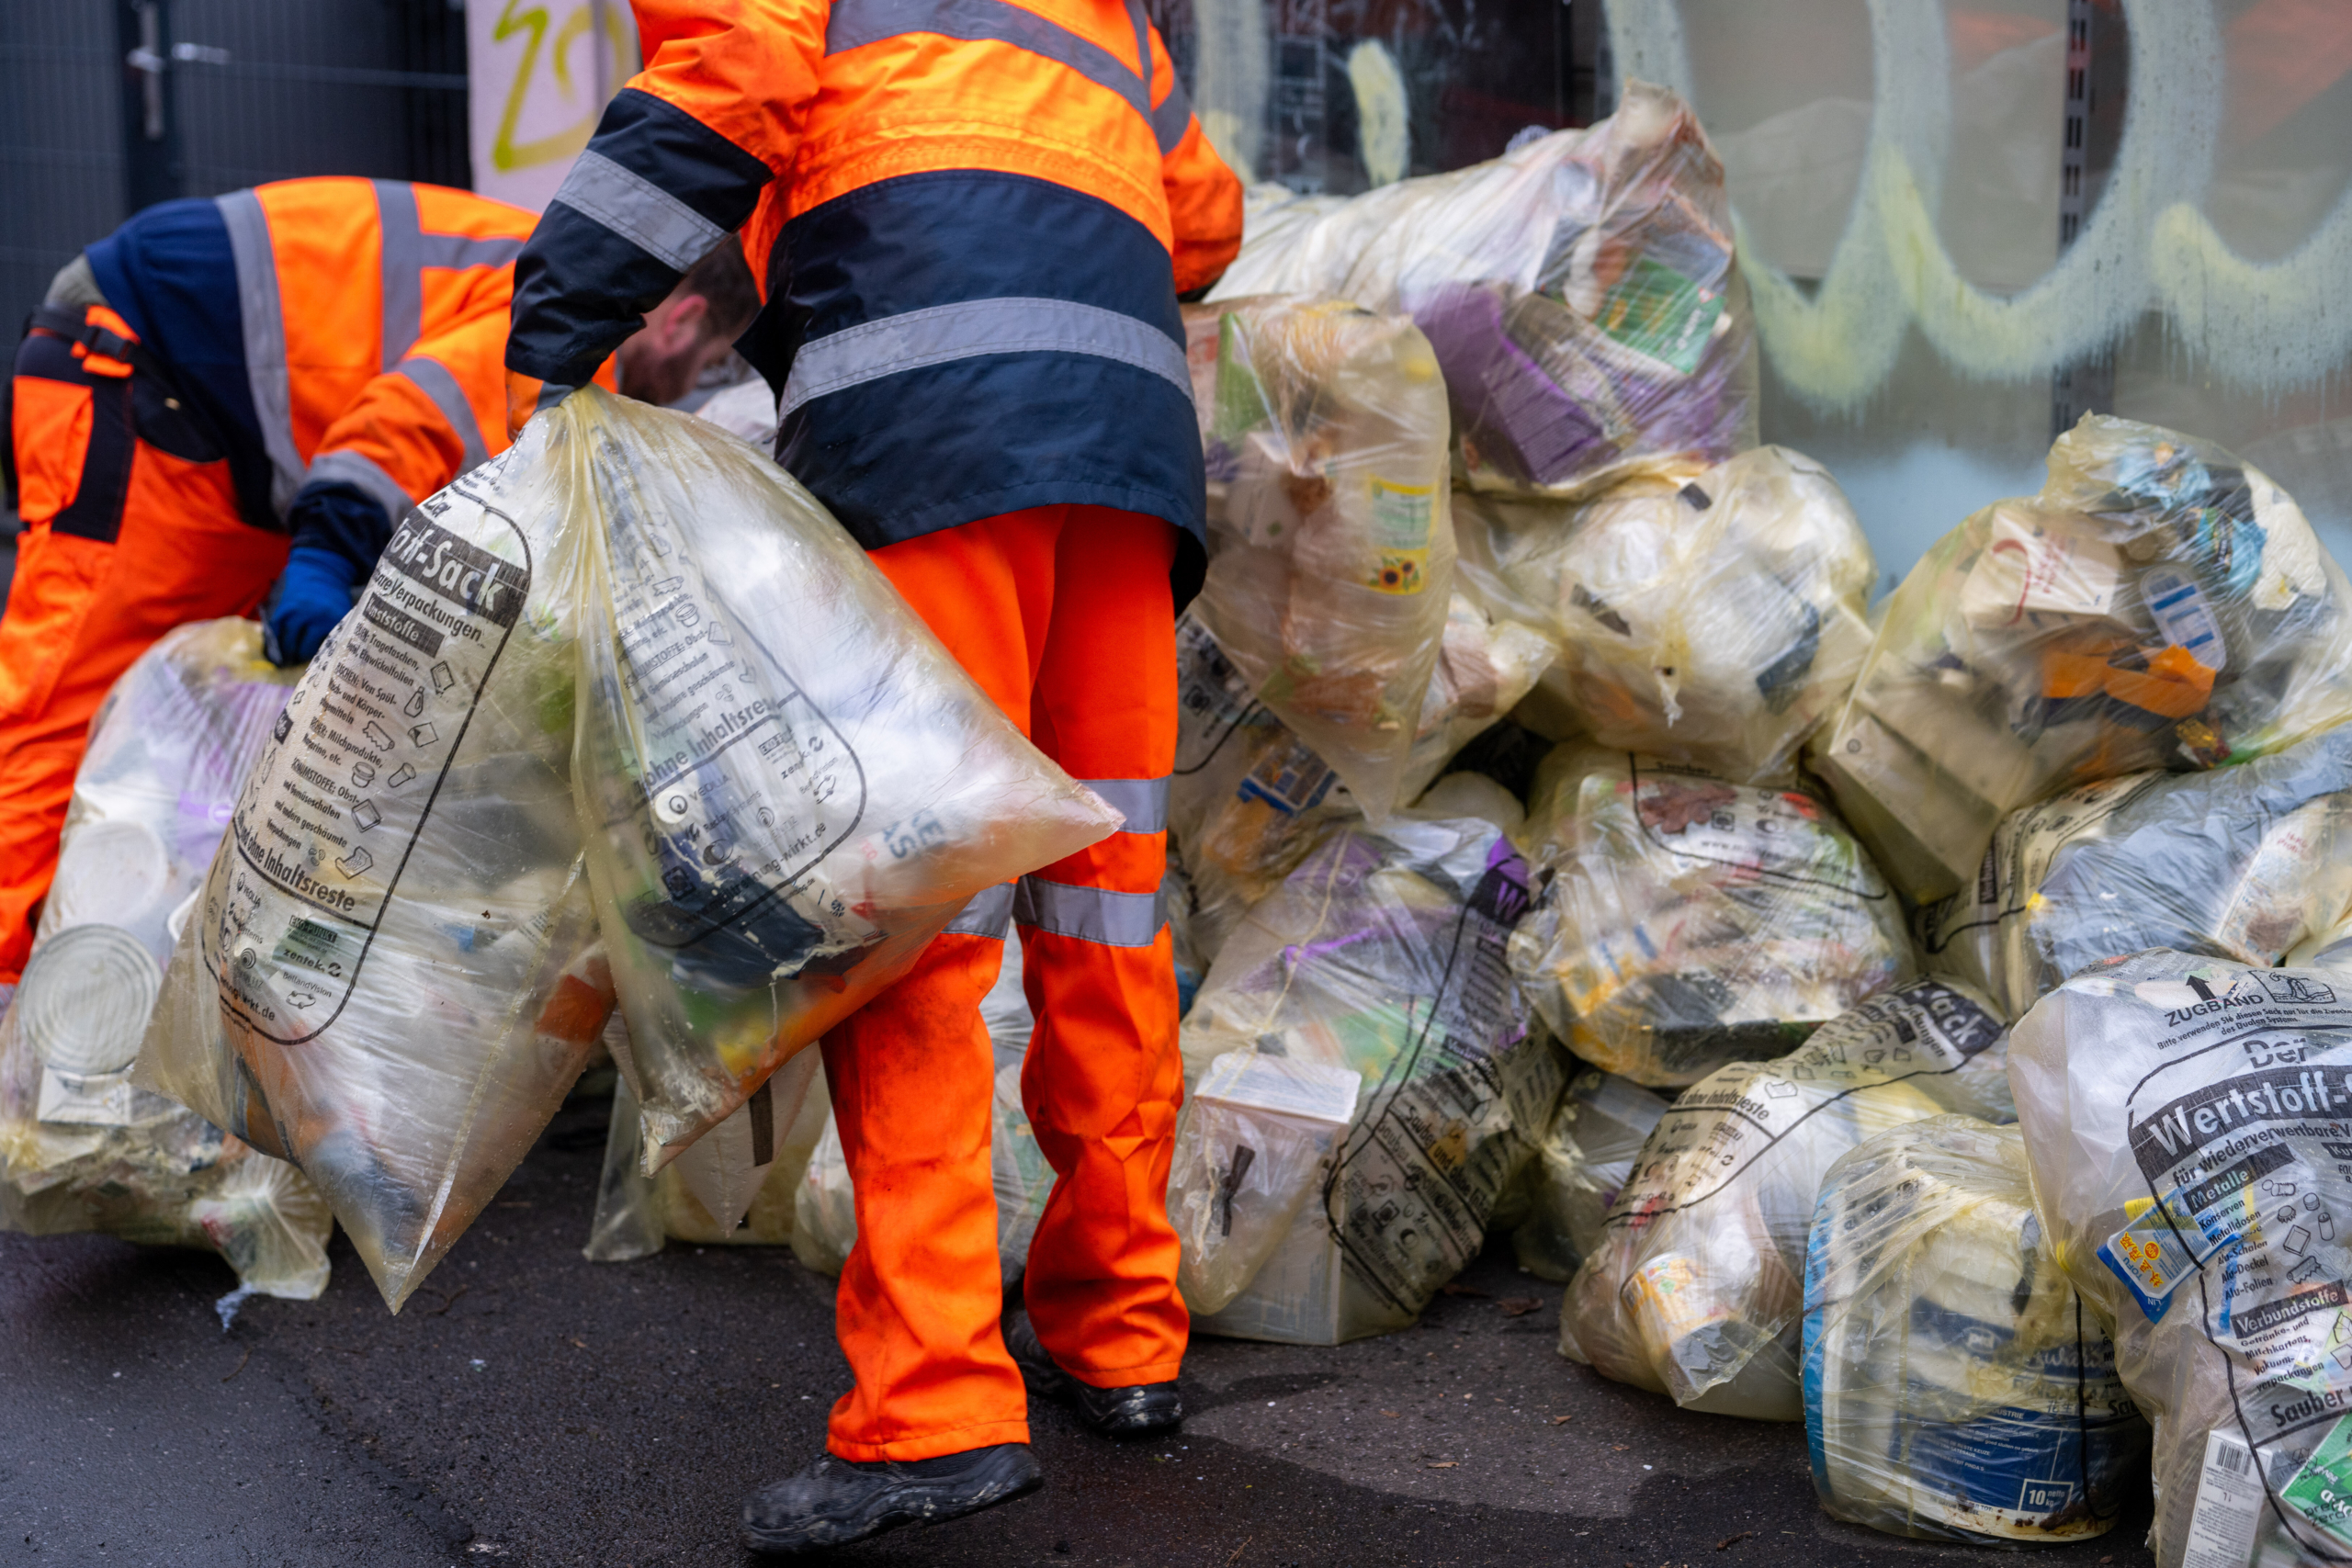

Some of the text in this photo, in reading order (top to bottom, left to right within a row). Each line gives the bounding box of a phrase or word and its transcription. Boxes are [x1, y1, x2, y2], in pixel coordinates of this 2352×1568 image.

[369, 633, 419, 671] Tragetaschen,
[361, 678, 377, 695] Von
[376, 687, 398, 705] Spül-
[342, 692, 356, 705] und
[356, 697, 386, 721] Körper-
[327, 728, 384, 769] Milchprodukte,
[328, 752, 342, 766] etc.
[645, 750, 689, 785] ohne
[290, 784, 342, 820] Gemüseschalen
[337, 785, 360, 805] Obst-
[688, 774, 729, 801] VEOLIA
[301, 818, 349, 849] geschäumte
[264, 847, 356, 912] Inhaltsreste
[288, 915, 338, 943] EKO-PUNKT
[282, 971, 332, 998] BellandVision
[2164, 994, 2264, 1028] ZUGBAND
[2156, 1035, 2178, 1051] Bitte
[2177, 1019, 2222, 1043] verwenden
[2234, 1010, 2263, 1021] diesen
[2263, 1008, 2282, 1017] Sack
[2221, 1023, 2236, 1036] des
[2236, 1018, 2267, 1031] Dualen
[2243, 1037, 2309, 1069] Der
[1405, 1105, 1439, 1148] Sauber
[2172, 1166, 2198, 1189] für
[2198, 1122, 2339, 1174] wiederverwertbare
[2191, 1169, 2251, 1209] Metalle
[2199, 1199, 2245, 1231] Konserven
[2208, 1210, 2262, 1247] Metalldosen
[2122, 1257, 2143, 1281] TOFU
[2221, 1255, 2269, 1284] Alu-Deckel
[2147, 1296, 2163, 1306] LIN
[2224, 1278, 2273, 1301] Alu-Folien
[2236, 1288, 2339, 1333] Verbundstoffe
[2240, 1315, 2310, 1347] Getränke- und
[2245, 1335, 2312, 1360] Milchkartons,
[2254, 1356, 2296, 1376] Vakuum-
[2256, 1361, 2325, 1392] verpackungen
[2270, 1388, 2345, 1428] Sauber
[1973, 1447, 1991, 1457] KEUZE
[1984, 1439, 1998, 1449] goed
[1997, 1441, 2014, 1450] sluiten
[1963, 1460, 1985, 1472] PINDA'S
[2028, 1489, 2065, 1506] 10 netto
[2045, 1499, 2055, 1508] kg
